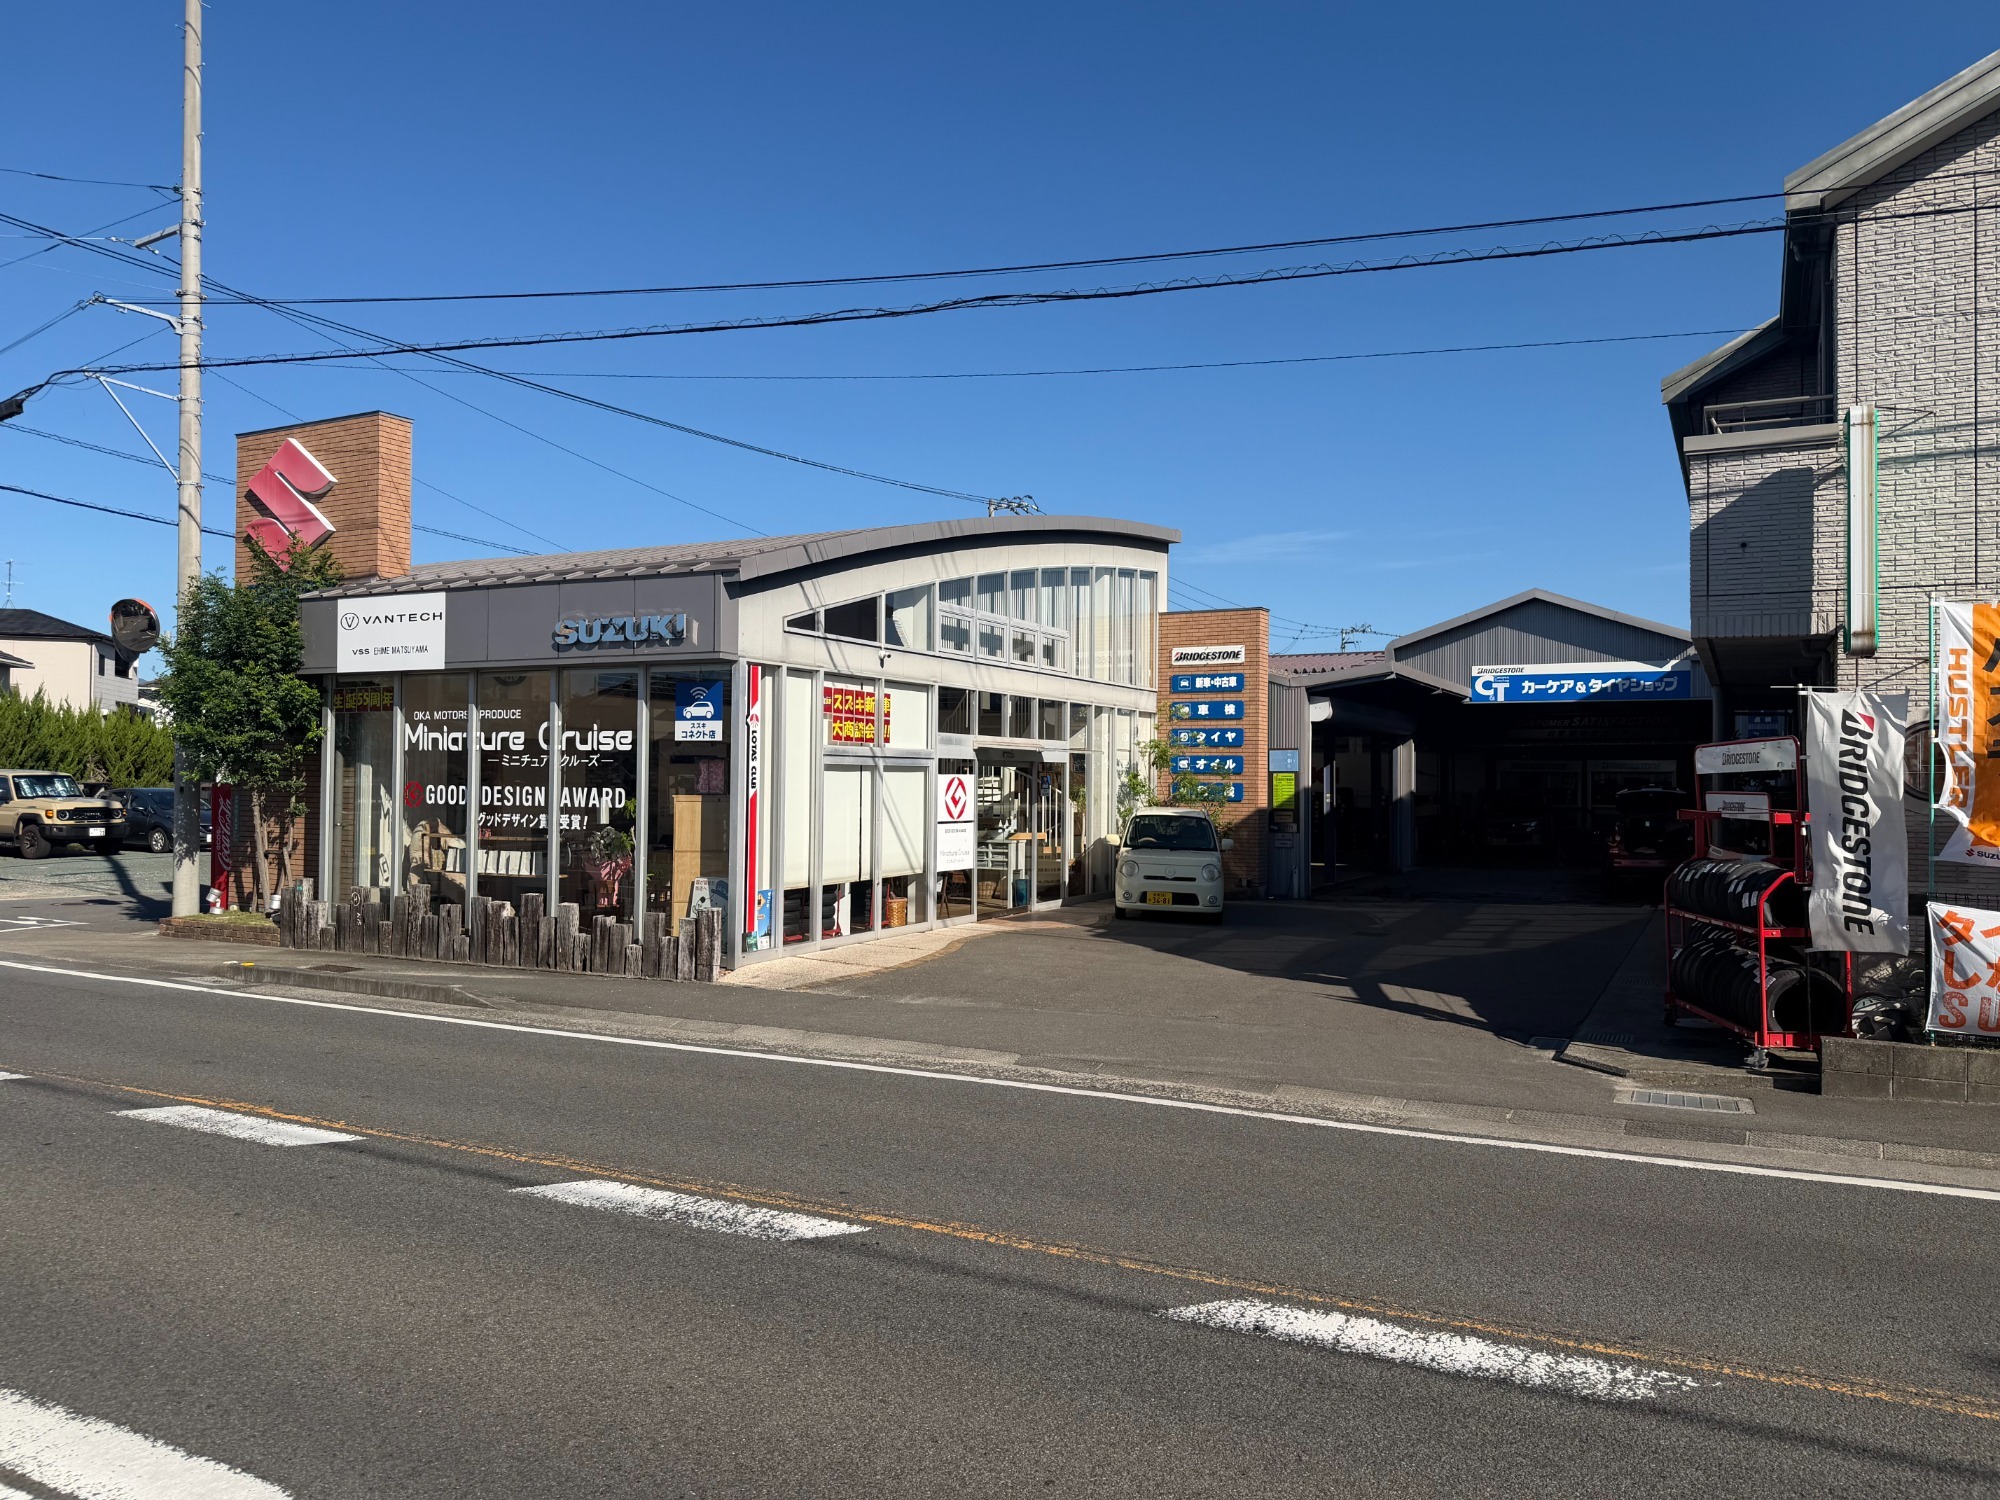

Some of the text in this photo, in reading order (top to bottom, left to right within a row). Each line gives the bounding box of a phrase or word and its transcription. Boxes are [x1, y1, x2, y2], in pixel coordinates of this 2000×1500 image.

[363, 612, 443, 625] VANTECH
[554, 613, 687, 645] SUZUKI
[373, 647, 390, 655] EHIME
[391, 645, 428, 655] MATSUYAMA
[1174, 651, 1242, 662] BRIDGESTONE
[1477, 667, 1525, 675] BRIDGESTONE
[413, 709, 521, 720] OKA MOTORS PRODUCE
[681, 730, 716, 739] コネクト店
[1947, 647, 1970, 809] HUSTLER
[538, 720, 633, 751] Cruise
[1195, 731, 1237, 743] タイヤ
[1722, 751, 1761, 766] BRIDGESTONE
[426, 784, 626, 809] GOOD DESIGN AWARD
[1838, 708, 1875, 936] BRIDGESTONE
